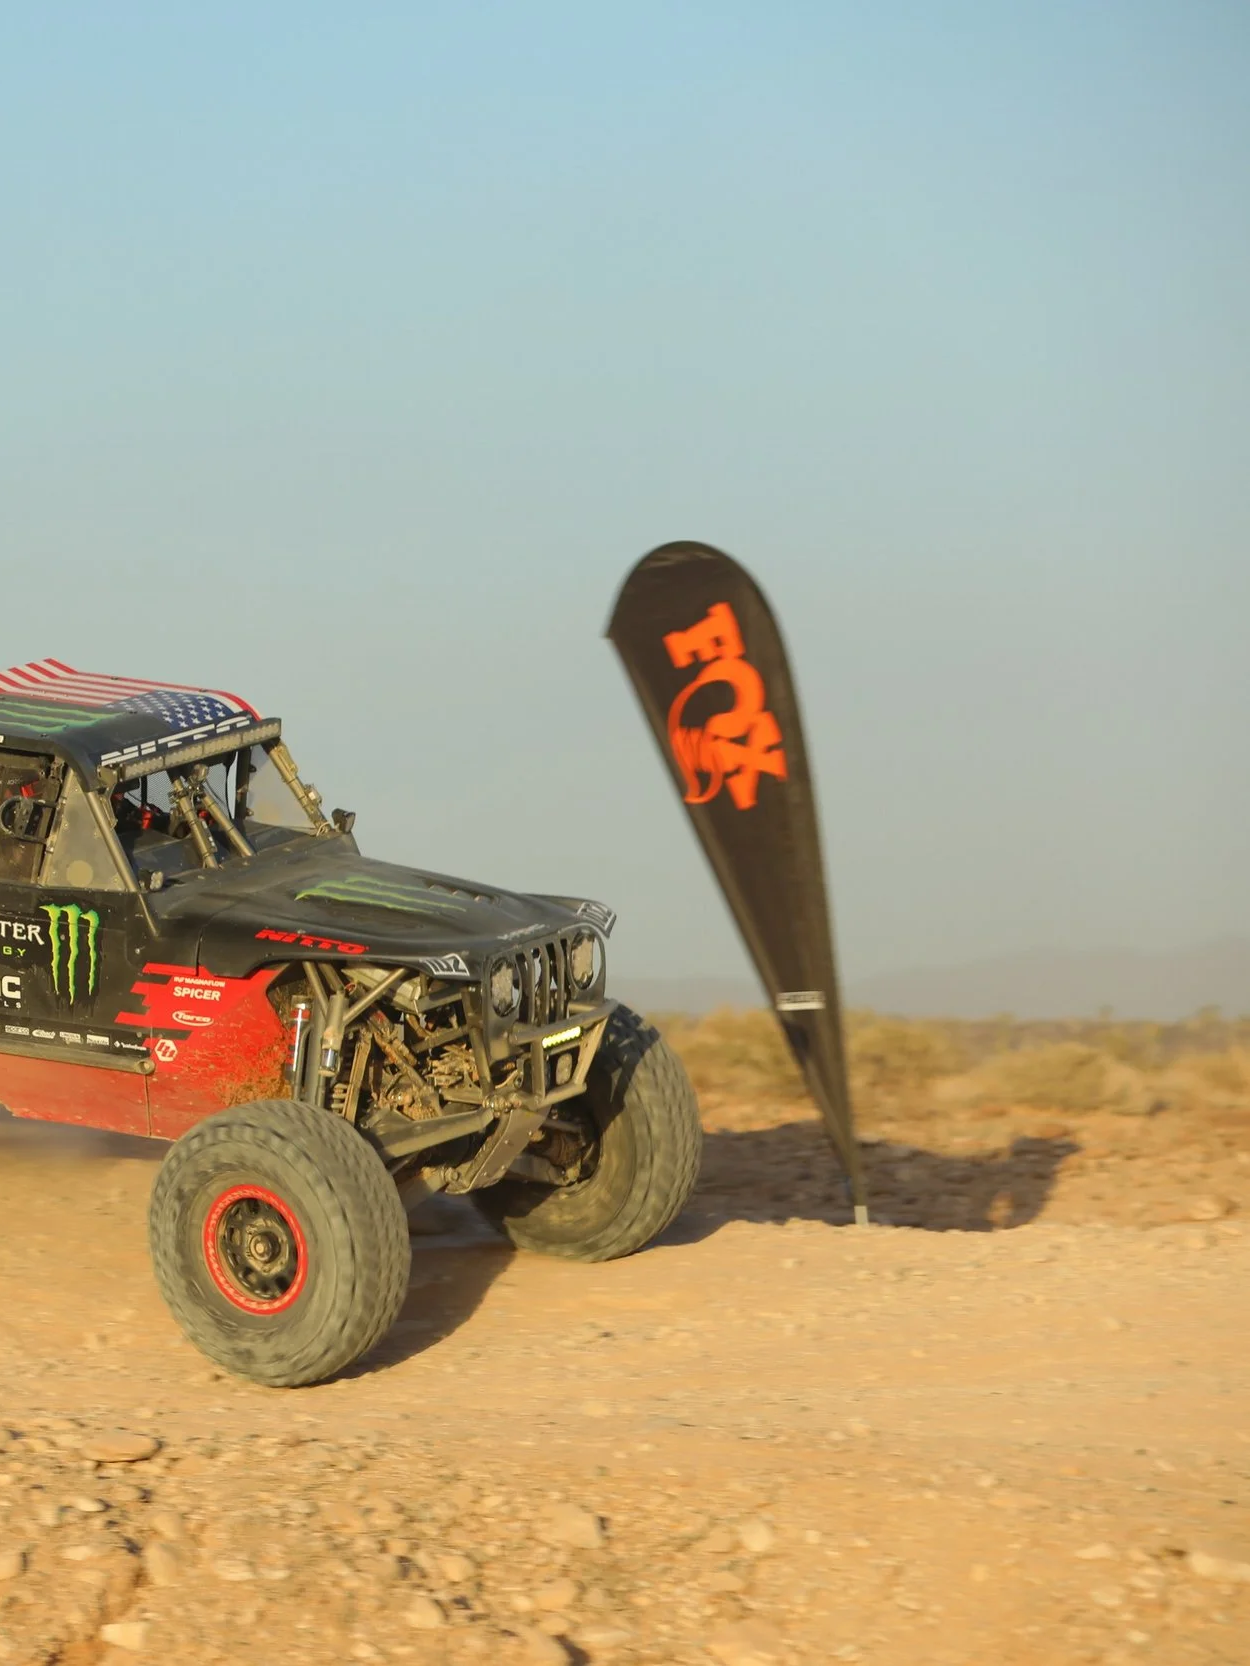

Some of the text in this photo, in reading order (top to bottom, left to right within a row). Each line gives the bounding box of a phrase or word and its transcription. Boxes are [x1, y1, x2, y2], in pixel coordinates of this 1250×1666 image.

[663, 602, 787, 811] FOX
[254, 929, 366, 955] NITTO
[173, 985, 221, 1001] SPICER
